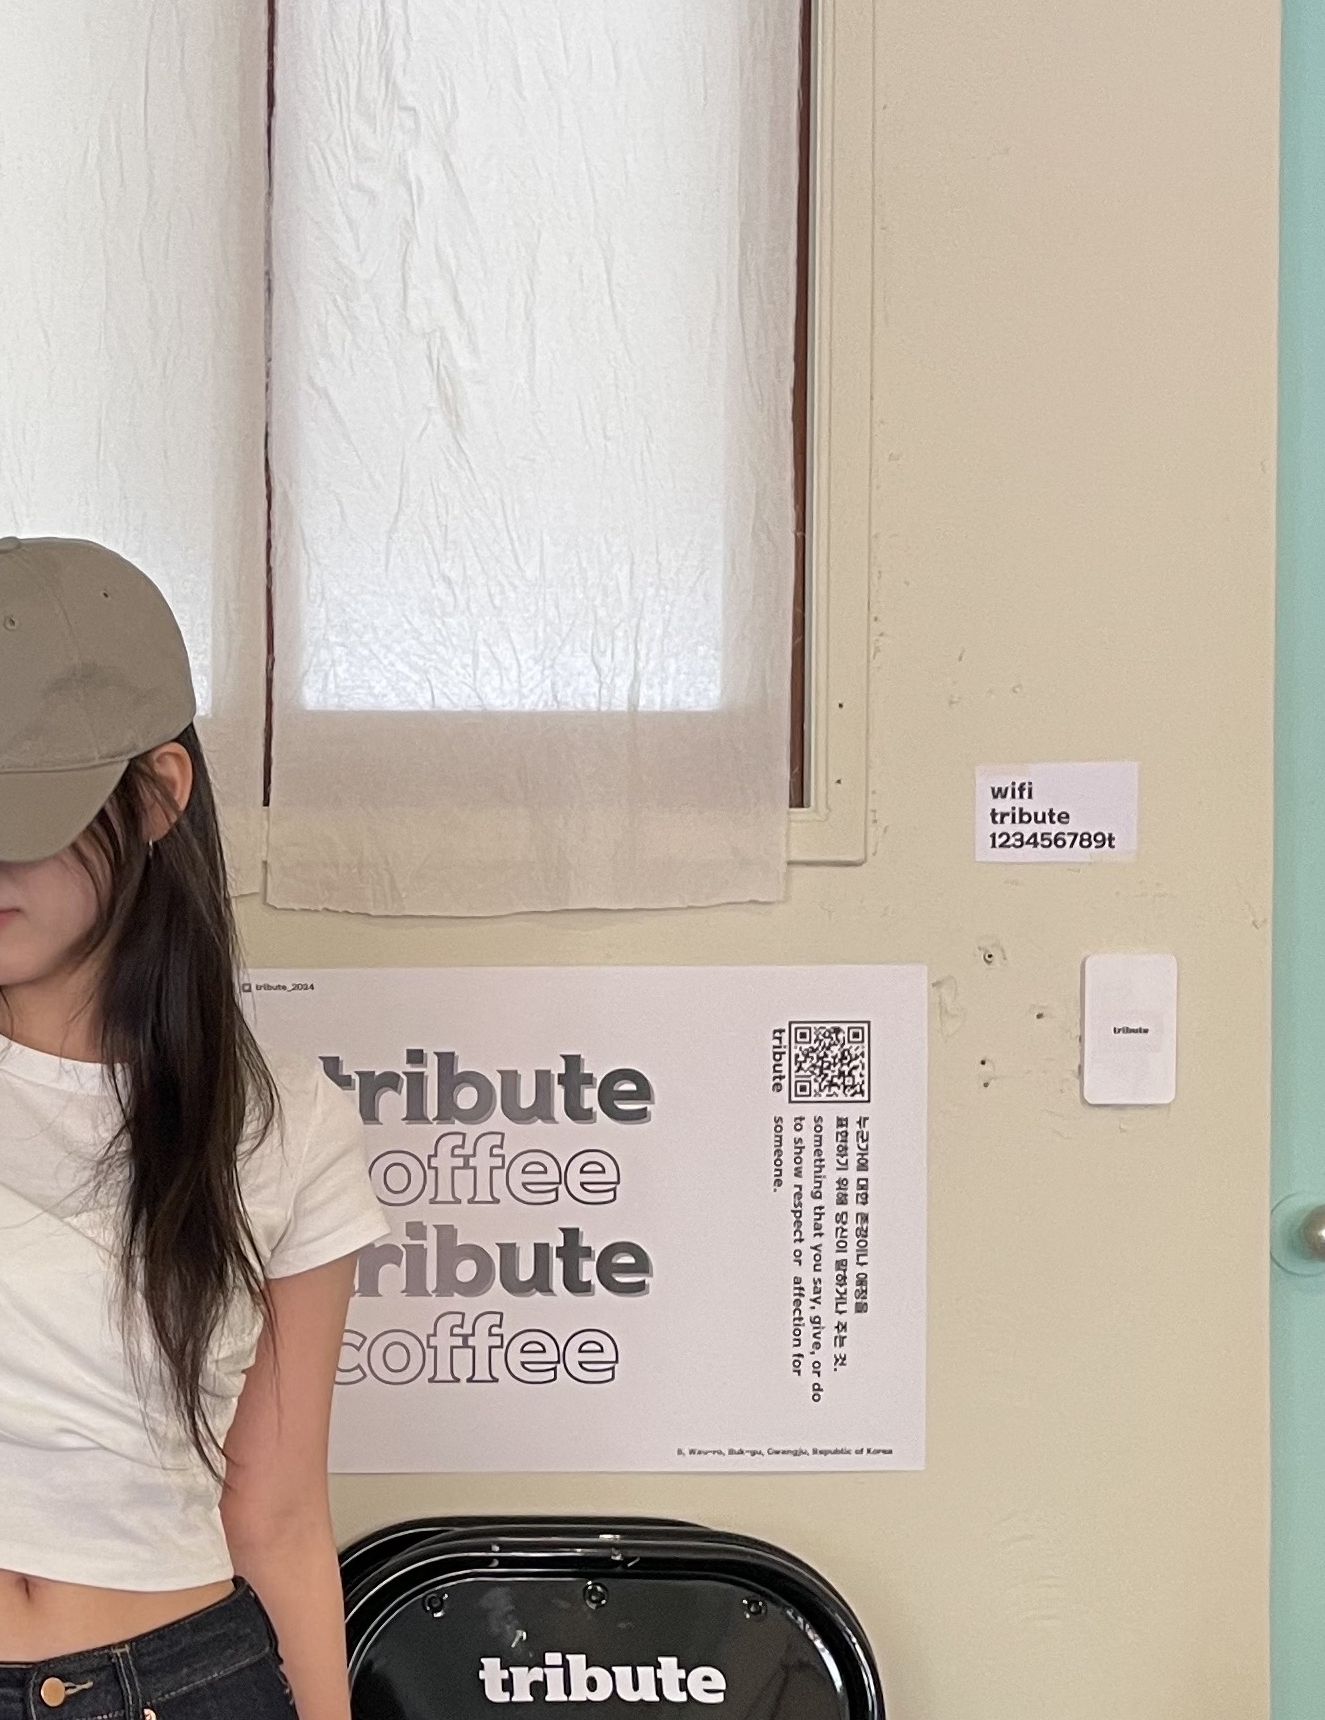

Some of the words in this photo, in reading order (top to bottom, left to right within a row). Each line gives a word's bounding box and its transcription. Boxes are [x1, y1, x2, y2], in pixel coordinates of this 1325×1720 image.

[990, 781, 1034, 800] wifi
[989, 807, 1071, 825] tribute
[989, 831, 1116, 849] 123456789t
[1113, 1026, 1150, 1034] tribute
[772, 1028, 786, 1093] tribute
[794, 1116, 805, 1132] to
[773, 1115, 784, 1193] someone.
[794, 1137, 806, 1178] show
[811, 1115, 826, 1200] something
[835, 1115, 849, 1171] 표현하기
[856, 1115, 869, 1172] 누군가에
[368, 1131, 621, 1206] offee
[835, 1177, 849, 1206] 위해
[856, 1178, 869, 1206] 대한
[791, 1184, 804, 1243] respect
[813, 1206, 825, 1238] that
[835, 1211, 848, 1253] 당신이
[855, 1212, 869, 1267] 존경이나
[353, 1221, 653, 1297] ribute
[793, 1249, 803, 1266] or
[810, 1243, 823, 1272] you
[810, 1277, 822, 1310] say,
[835, 1259, 848, 1315] 말하거나
[855, 1273, 868, 1314] 애정을
[793, 1276, 805, 1347] affection
[810, 1315, 825, 1355] give,
[834, 1320, 847, 1348] 주는
[792, 1353, 805, 1377] for
[812, 1360, 822, 1378] or
[834, 1353, 847, 1372] 것.
[812, 1382, 823, 1402] do
[812, 1447, 852, 1457] Republic
[855, 1447, 864, 1455] of
[866, 1447, 893, 1455] Korea
[479, 1651, 727, 1704] tribute
